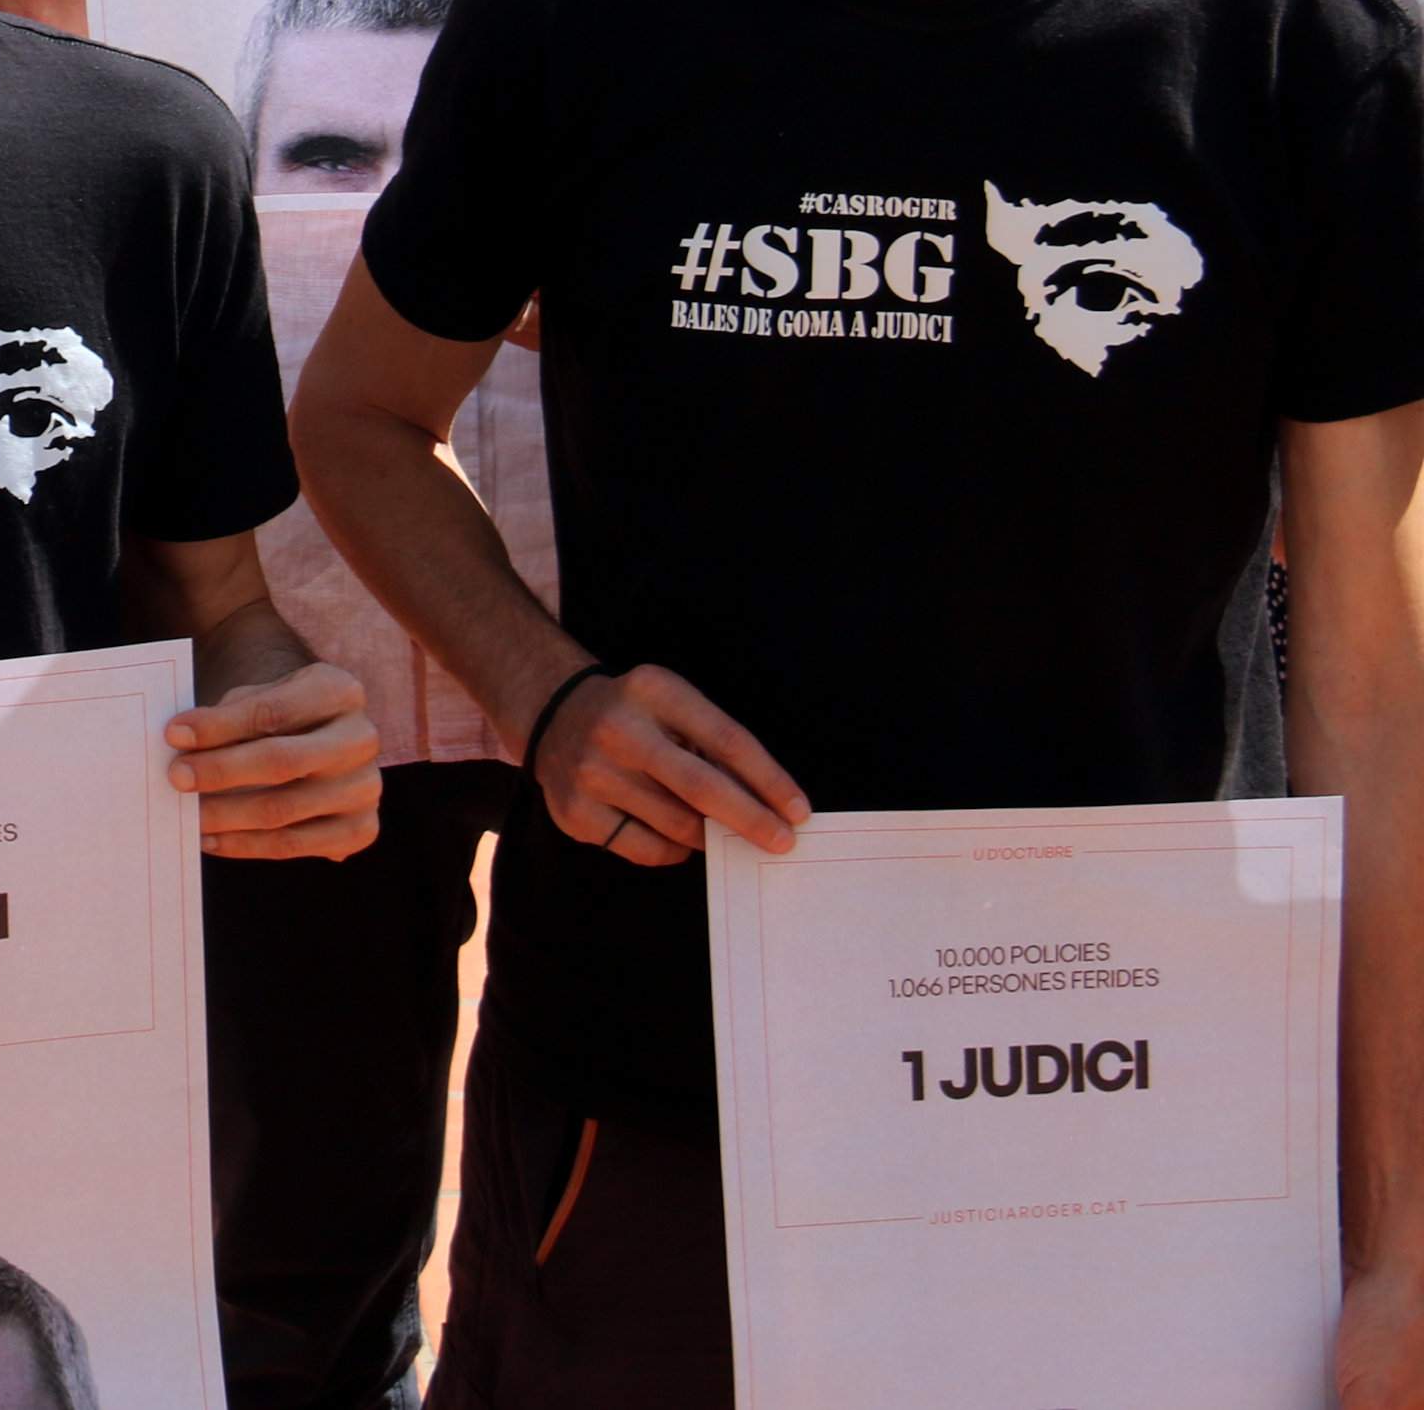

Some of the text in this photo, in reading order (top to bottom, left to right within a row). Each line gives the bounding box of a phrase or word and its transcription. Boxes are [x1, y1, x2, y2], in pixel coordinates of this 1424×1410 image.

[799, 193, 956, 220] #CASROGER
[671, 222, 955, 303] #SBG
[671, 300, 953, 343] BALES DE GOMA A JUDICI
[973, 846, 1073, 860] U D'OCTUBRE
[936, 943, 1111, 968] 10.000 POLICIES
[889, 968, 1160, 998] 1.066 PERSONES FERIDES
[902, 1040, 1149, 1101] 1 JUDICI
[928, 1200, 1128, 1225] JUSTICIAROGER.CAT
